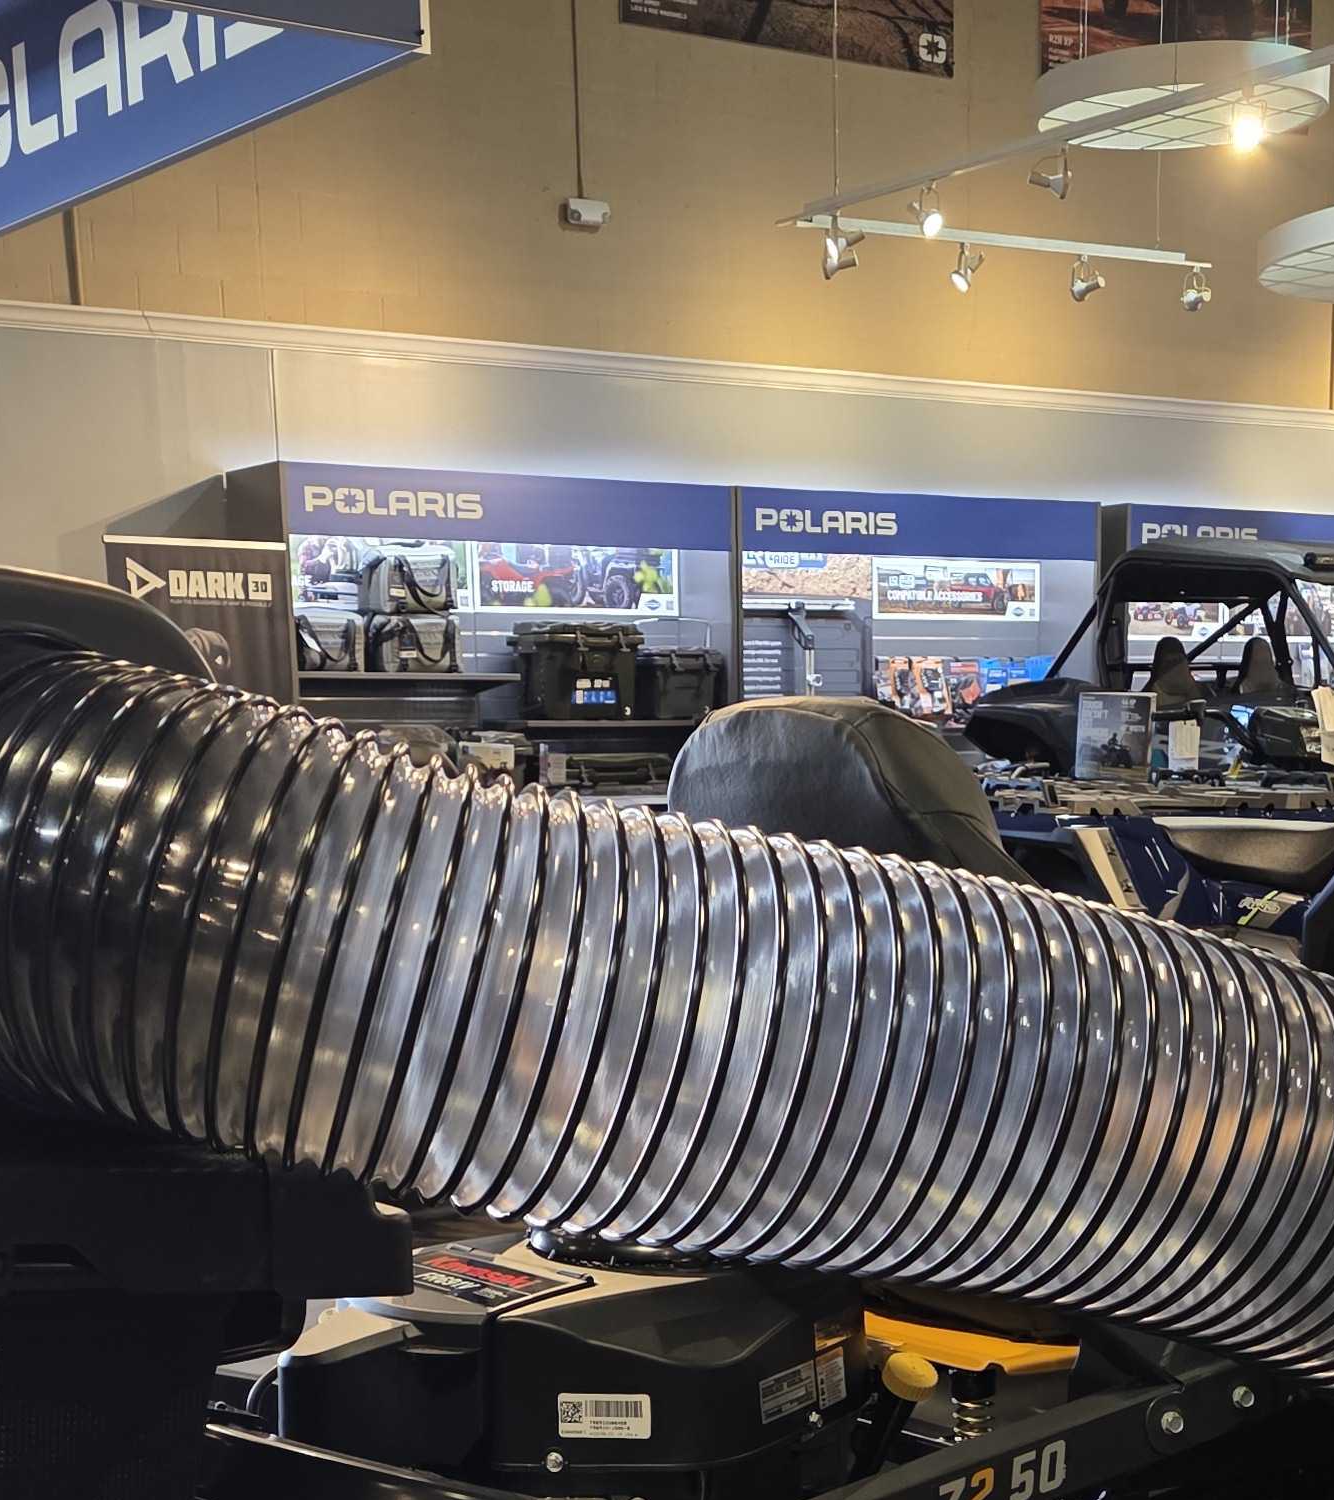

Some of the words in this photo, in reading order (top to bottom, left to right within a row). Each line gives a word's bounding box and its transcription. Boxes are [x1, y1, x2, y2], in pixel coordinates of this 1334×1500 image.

[303, 485, 483, 520] POLARIS
[755, 507, 898, 536] POLARIS
[168, 569, 245, 600] DARK
[491, 579, 535, 593] STORAGE
[425, 1254, 539, 1290] Kawasaki
